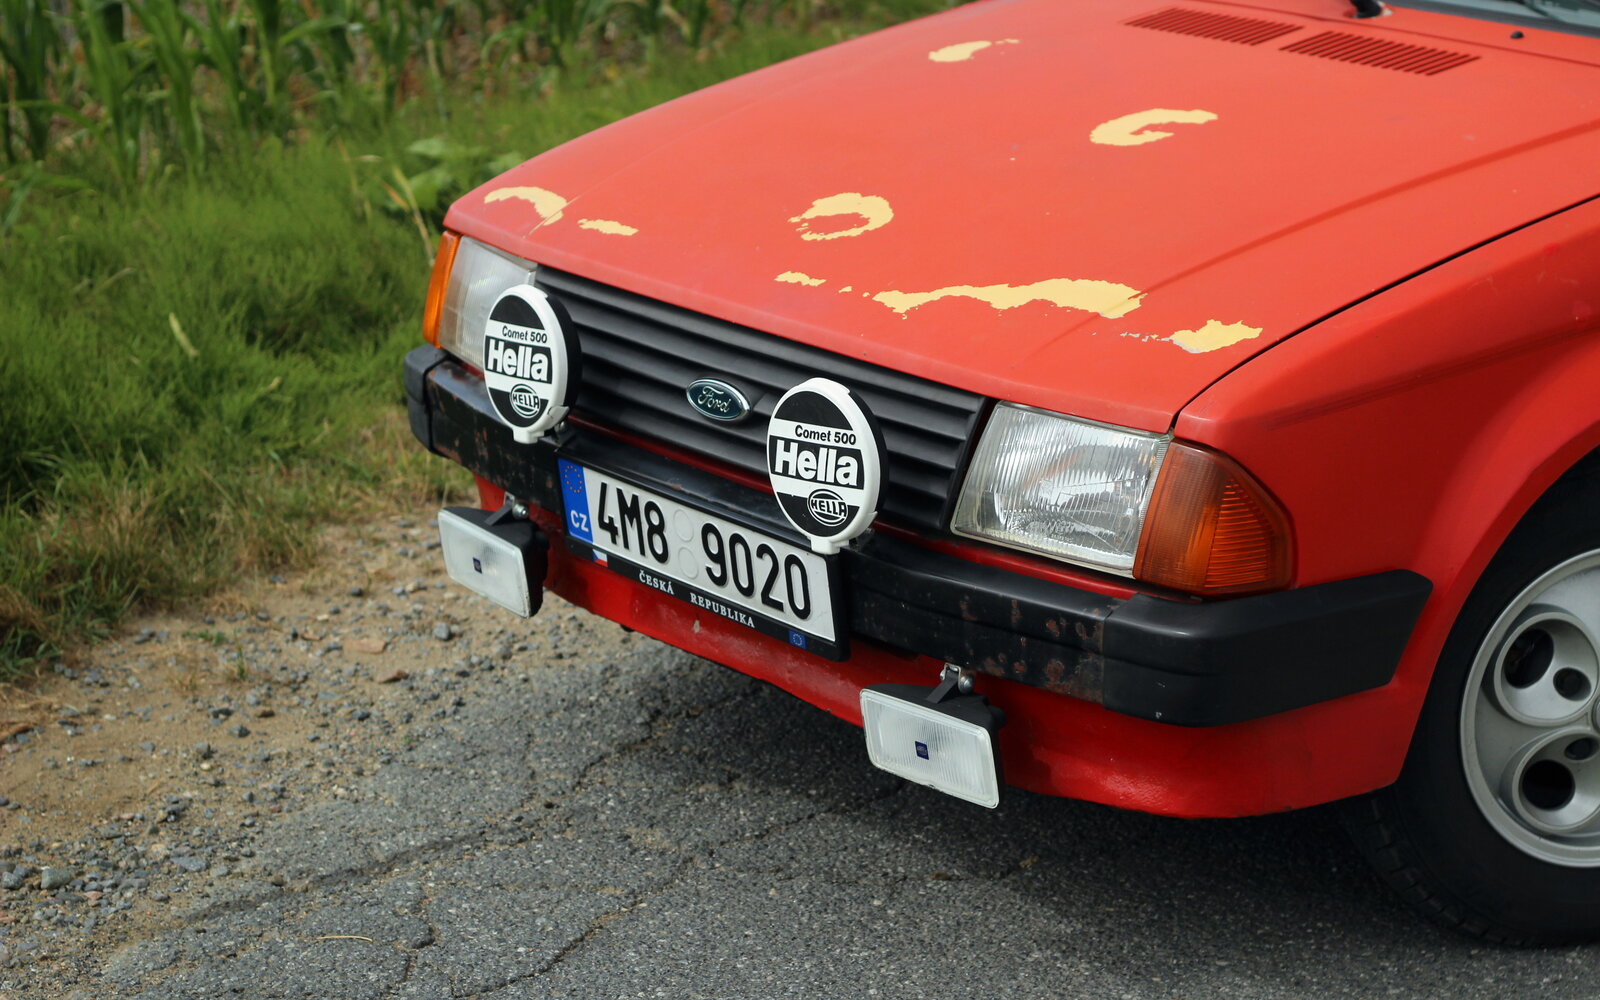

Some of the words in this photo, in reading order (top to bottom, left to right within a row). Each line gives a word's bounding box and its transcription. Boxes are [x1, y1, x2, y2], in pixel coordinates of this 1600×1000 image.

[502, 325, 528, 342] Comet
[530, 331, 548, 344] 500
[487, 338, 549, 382] Hella
[512, 393, 540, 410] HELLA
[697, 385, 732, 413] Ford
[795, 424, 832, 442] Comet
[834, 431, 857, 445] 500
[774, 439, 859, 487] Hella
[810, 498, 847, 518] HELLA
[570, 510, 589, 533] CZ
[598, 481, 669, 564] 4M8
[701, 522, 811, 620] 9020
[639, 569, 675, 596] ČESKÁ
[690, 592, 756, 629] REPUBLIKA
